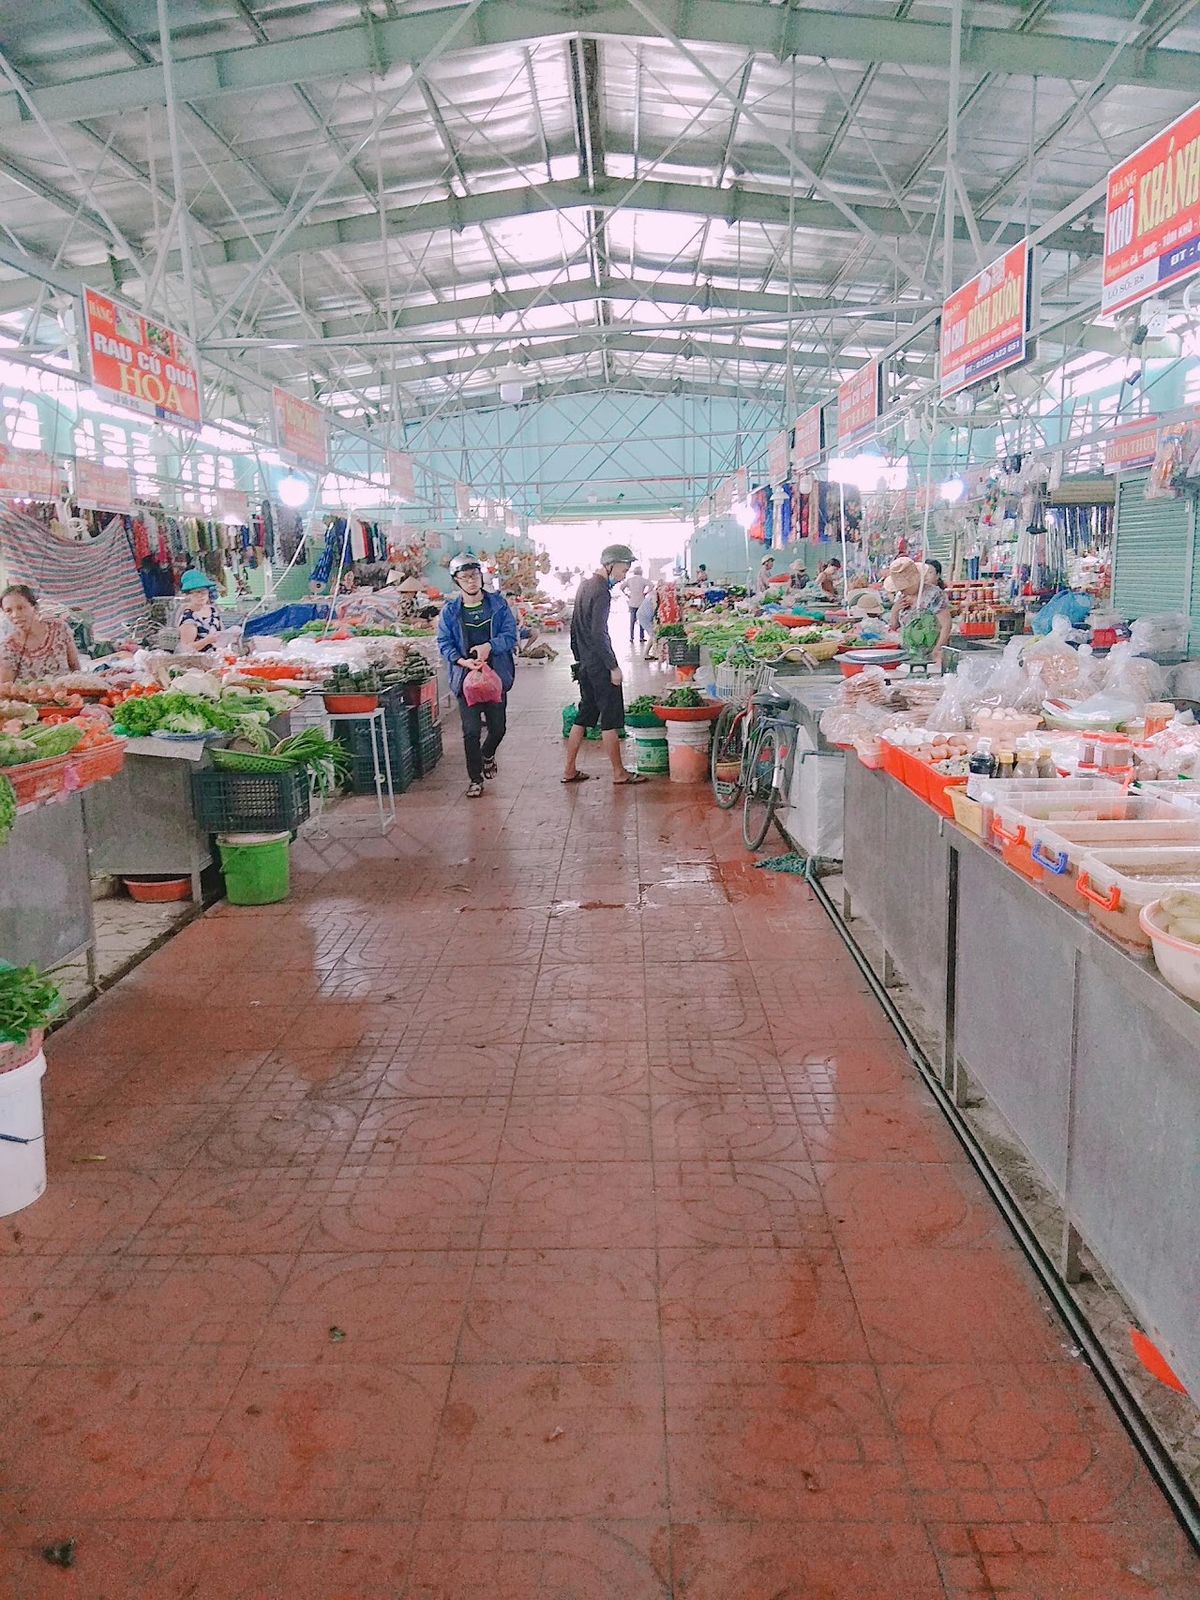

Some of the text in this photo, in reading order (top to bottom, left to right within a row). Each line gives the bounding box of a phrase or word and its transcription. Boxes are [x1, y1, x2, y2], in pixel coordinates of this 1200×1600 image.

[93, 331, 196, 391] RAU CỦ QUẢ
[117, 362, 185, 413] HOA
